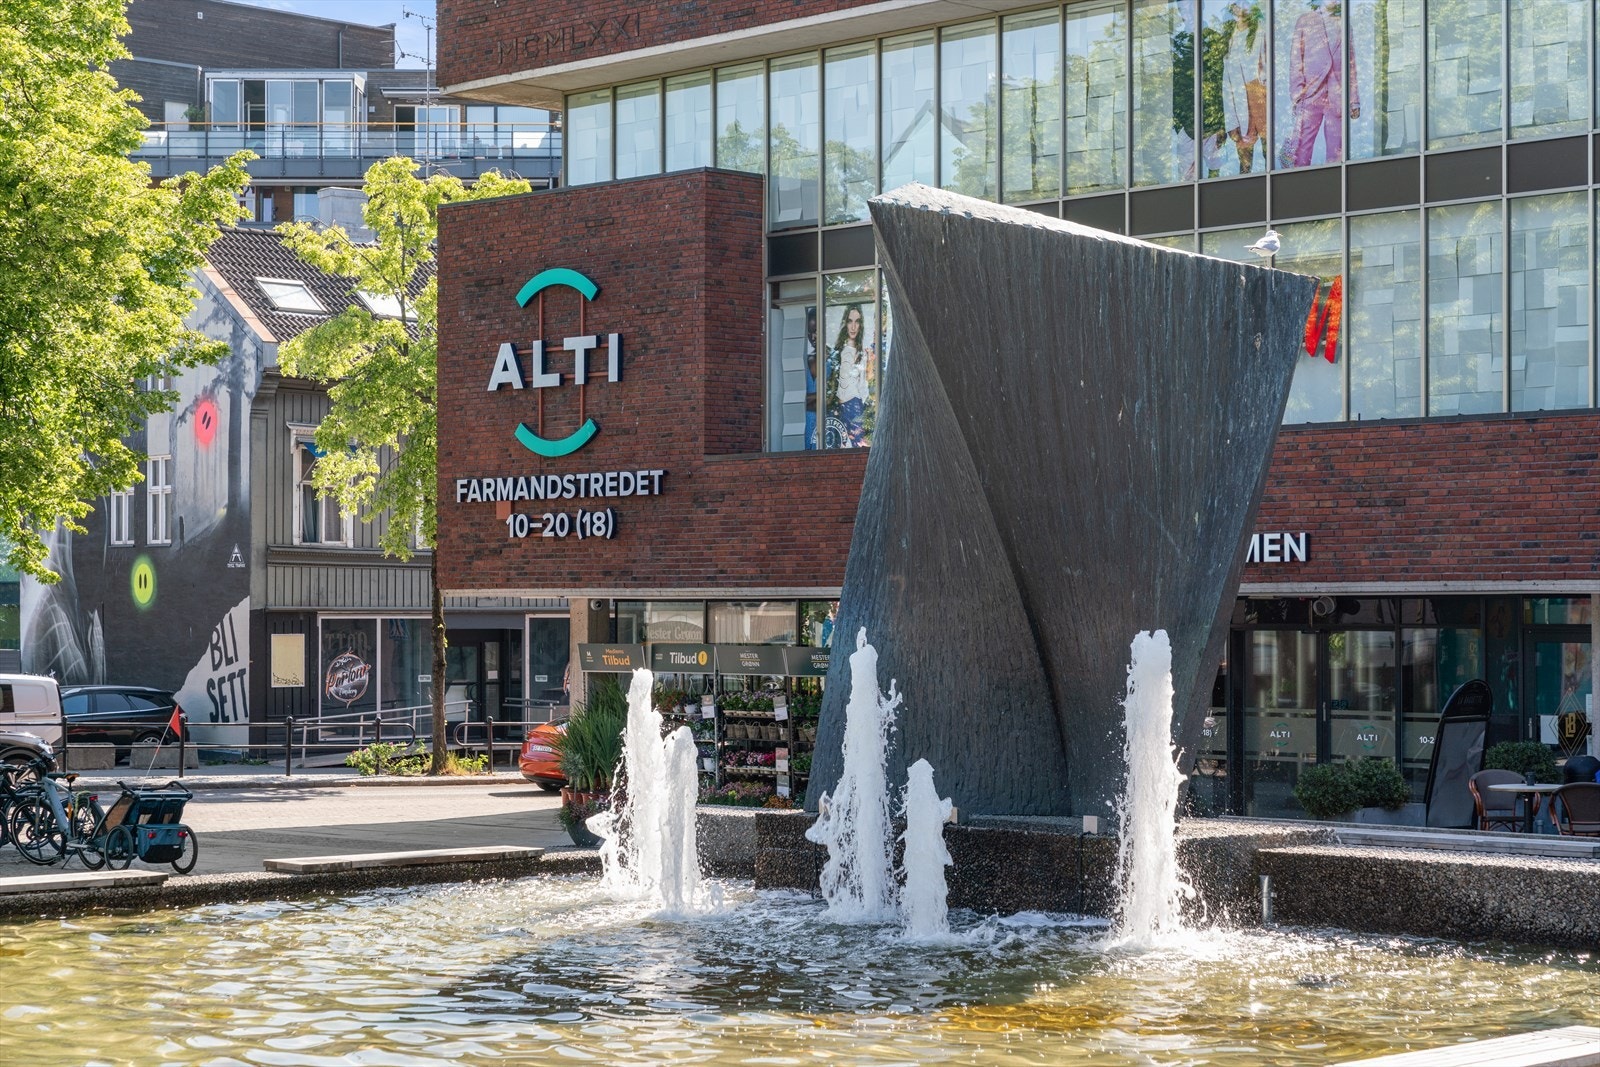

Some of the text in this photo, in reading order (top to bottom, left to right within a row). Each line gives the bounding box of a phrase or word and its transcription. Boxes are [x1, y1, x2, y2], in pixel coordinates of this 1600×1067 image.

[497, 13, 641, 64] MCMLXXI
[487, 332, 623, 392] ALTI
[456, 469, 666, 503] FARMANDSTREDET
[575, 507, 615, 540] (18)
[210, 613, 239, 672] BLI
[602, 655, 631, 666] Tilbud
[206, 667, 249, 723] SETT
[1356, 734, 1378, 742] ALTI
